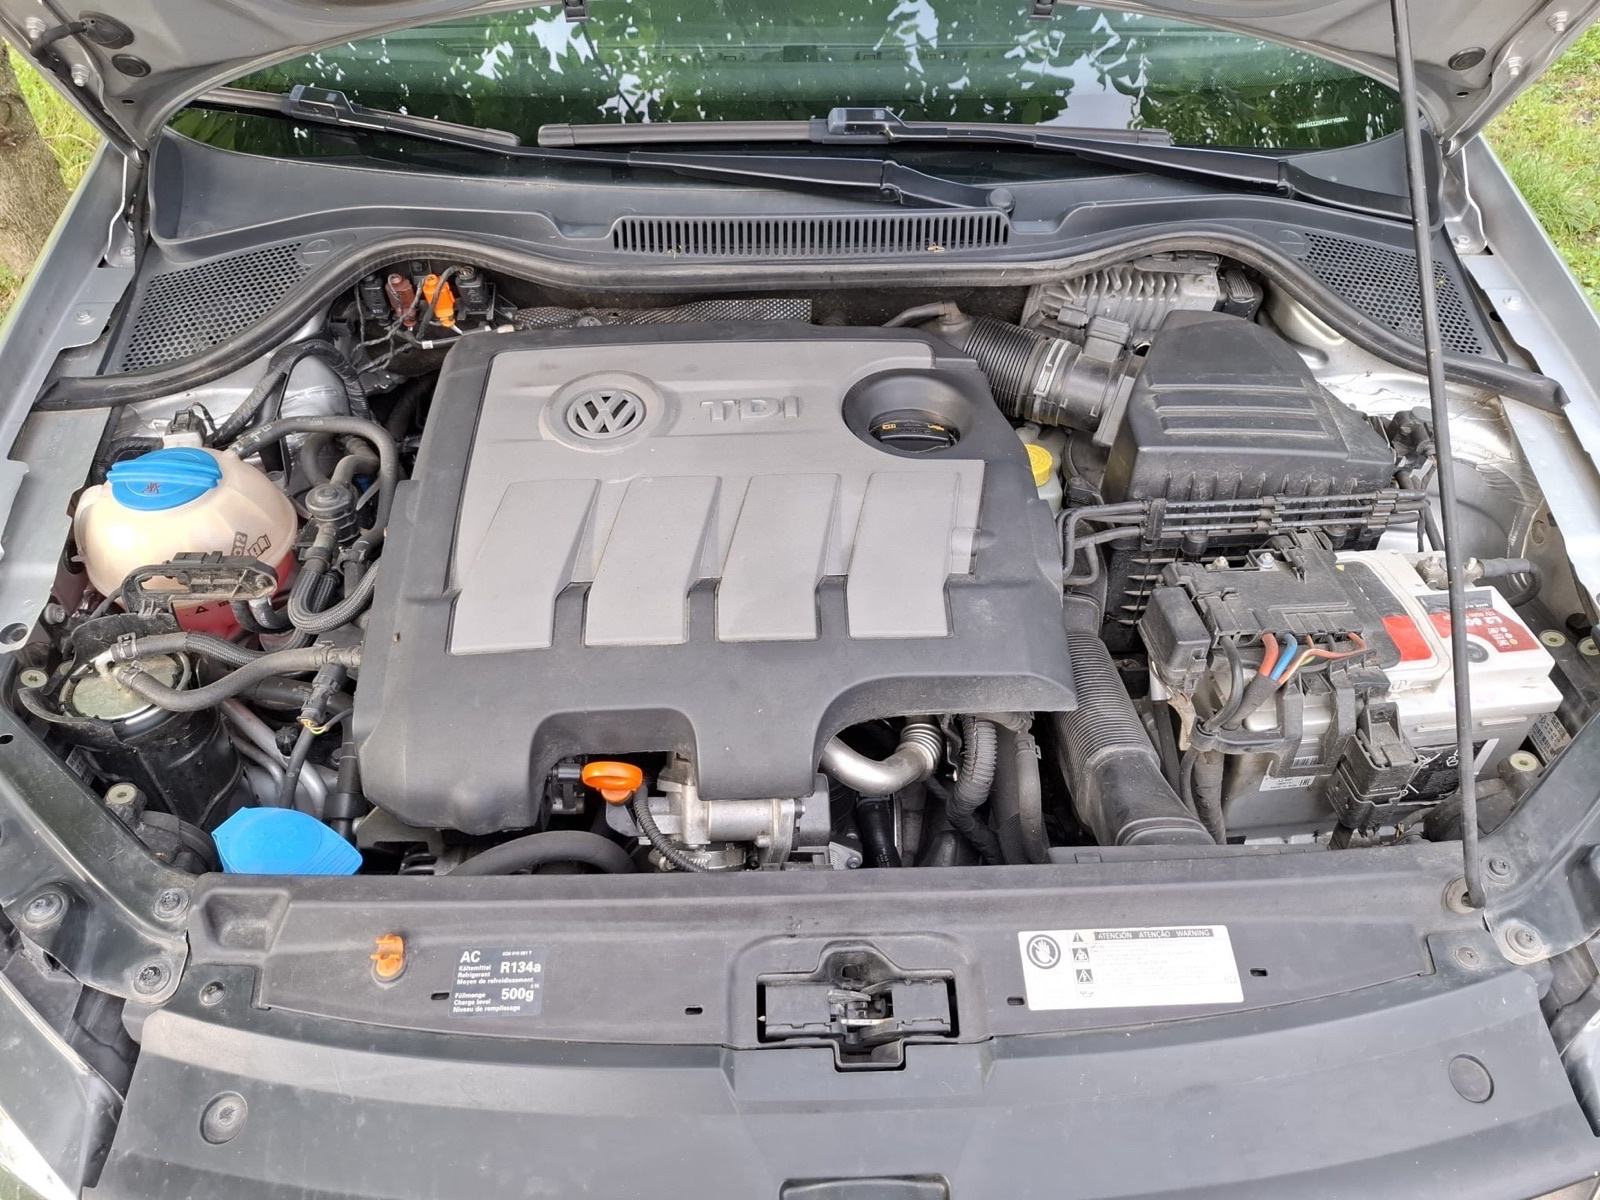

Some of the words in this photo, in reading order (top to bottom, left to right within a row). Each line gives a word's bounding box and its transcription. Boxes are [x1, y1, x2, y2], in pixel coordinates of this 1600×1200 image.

[567, 389, 647, 439] VW
[699, 396, 800, 423] TDI
[1098, 931, 1132, 940] ATENCIÓN
[1138, 929, 1171, 939] ATENÇÃO
[1176, 929, 1210, 937] WARNING
[460, 950, 481, 963] AC
[500, 961, 541, 974] R134a
[501, 987, 534, 1002] 500g
